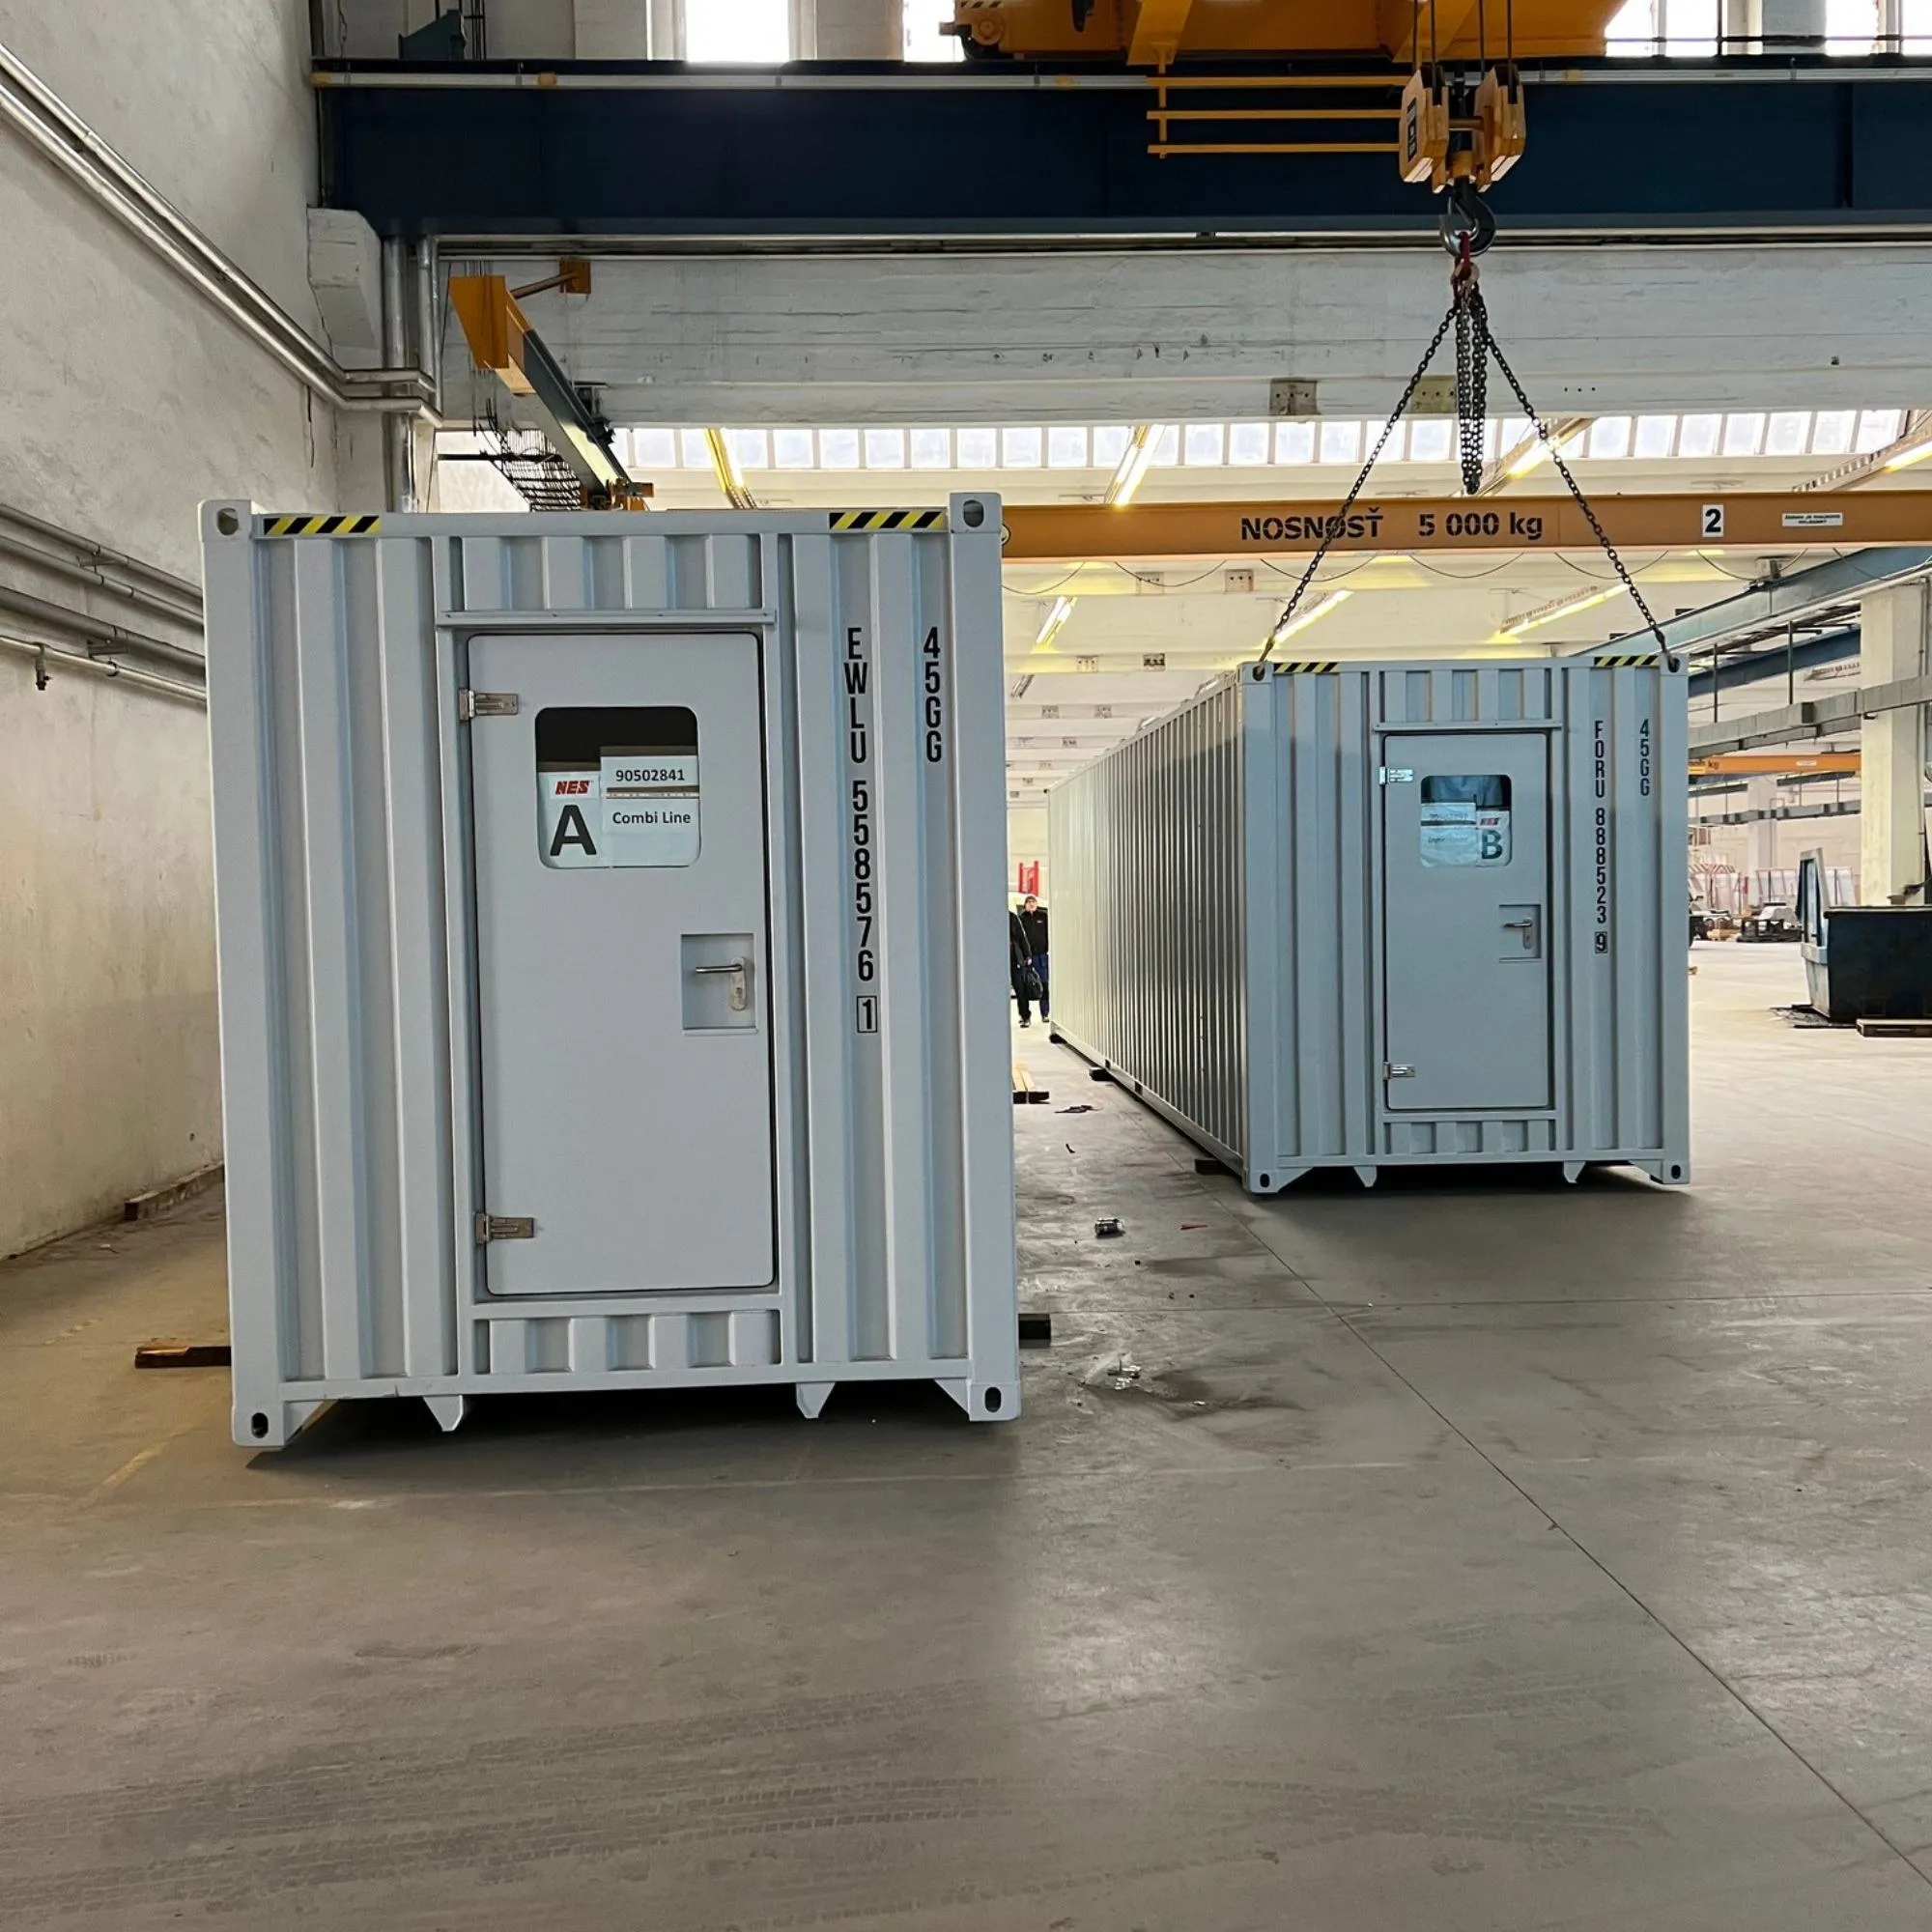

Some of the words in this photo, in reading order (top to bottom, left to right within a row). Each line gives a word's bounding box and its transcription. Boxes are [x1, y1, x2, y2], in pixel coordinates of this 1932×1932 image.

[1241, 506, 1383, 540] NOSNOSŤ
[1418, 513, 1435, 537] 5
[1445, 512, 1499, 536] 000
[1509, 512, 1543, 540] kg
[1705, 508, 1721, 532] 2
[844, 627, 867, 763] EWLU
[923, 626, 942, 762] 45GG
[615, 769, 685, 782] 90502841
[1594, 721, 1605, 798] FORU
[1639, 719, 1650, 796] 45GG
[555, 781, 589, 795] NES
[550, 804, 597, 856] A
[612, 811, 658, 824] Combi
[663, 811, 691, 824] Line
[1482, 830, 1503, 859] B
[1596, 808, 1606, 923] 888523
[852, 780, 874, 981] 558576
[1595, 933, 1606, 952] 9
